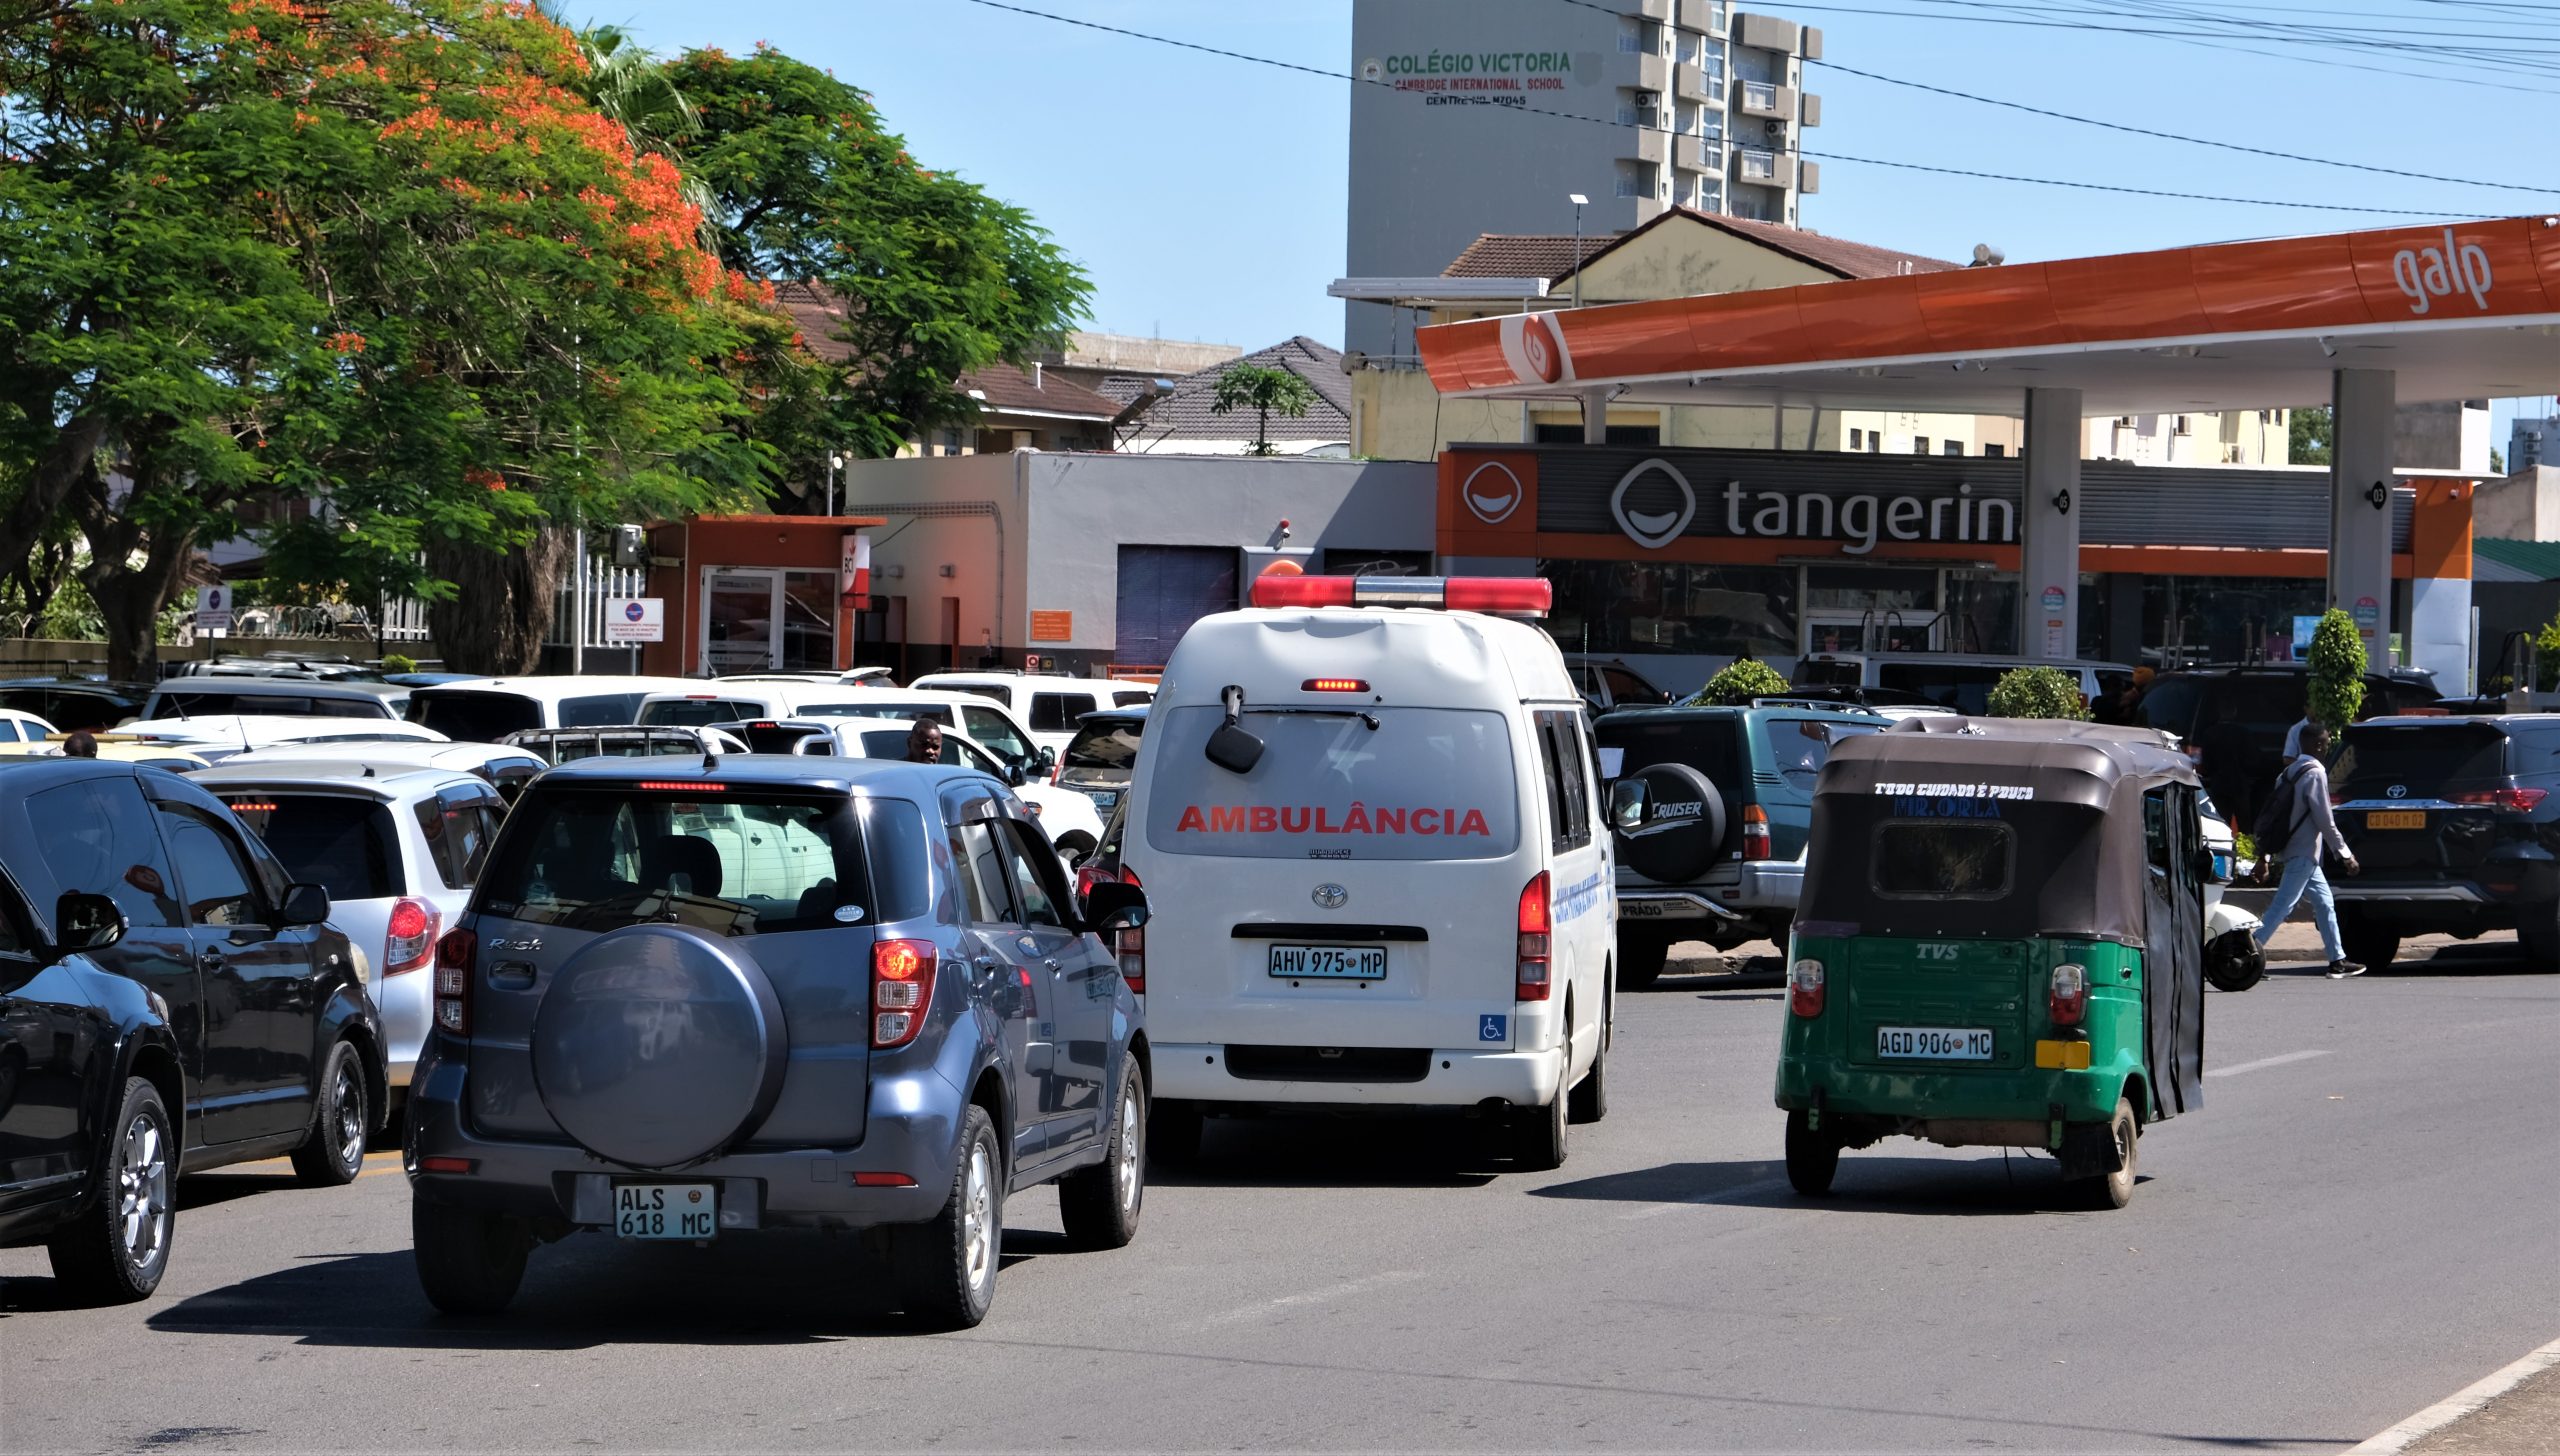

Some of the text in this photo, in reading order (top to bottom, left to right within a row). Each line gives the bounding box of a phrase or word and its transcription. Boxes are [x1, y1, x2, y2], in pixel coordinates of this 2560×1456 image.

[1386, 49, 1571, 74] COLÉGIO VICTORIA
[1395, 78, 1564, 91] CAMBRIDGE INTERNATIONAL SCHOOL
[2393, 228, 2492, 314] galp
[1722, 481, 2023, 554] tangerin
[1176, 802, 1491, 836] AMBULÂNCIA
[1652, 801, 1703, 819] CRUISER
[488, 938, 543, 951] Rush
[1916, 943, 1960, 960] TVS
[1272, 950, 1383, 974] AHV 975 MP
[1880, 1032, 1990, 1055] AGD 906 MC
[620, 1188, 665, 1211] ALS
[621, 1213, 711, 1235] 618 MC
